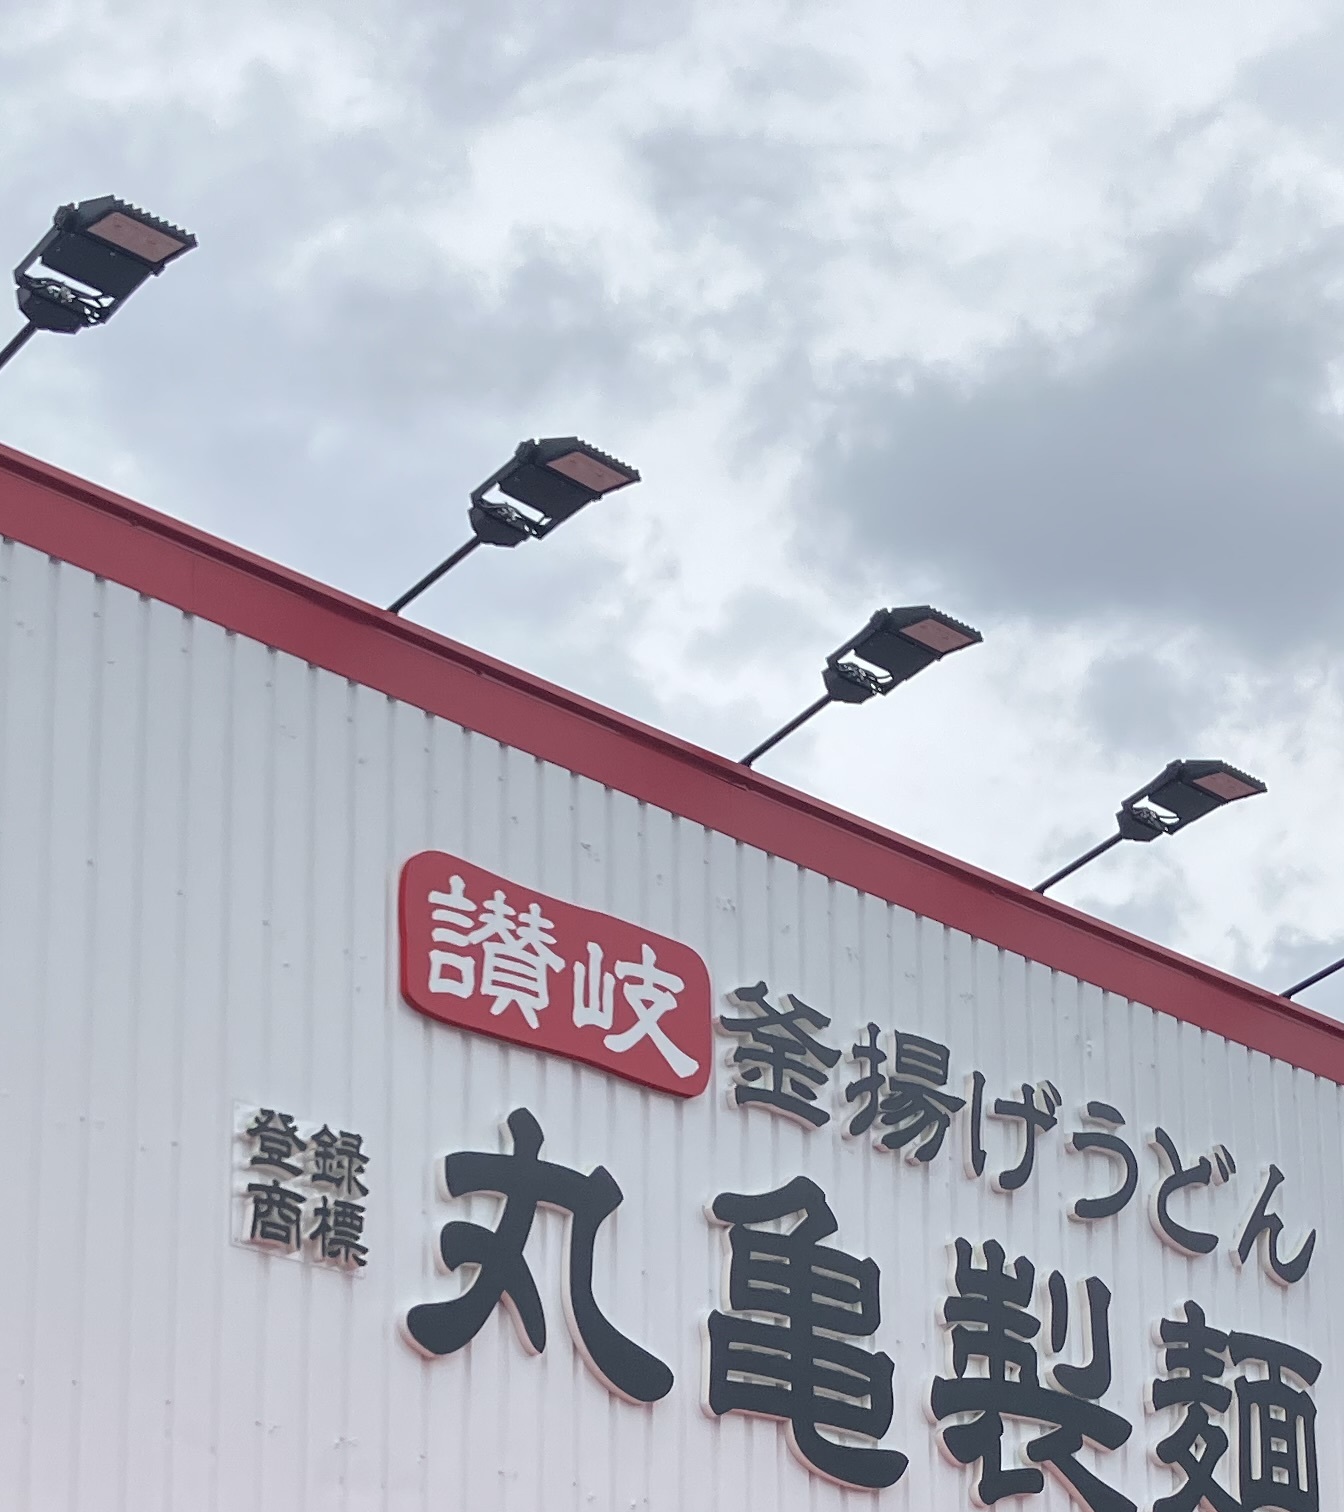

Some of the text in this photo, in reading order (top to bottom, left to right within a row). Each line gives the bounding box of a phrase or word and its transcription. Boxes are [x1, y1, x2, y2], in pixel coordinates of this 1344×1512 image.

[428, 875, 700, 1082] 讃岐
[247, 1108, 370, 1197] 登録
[718, 981, 1318, 1285] 釜揚げうどん
[248, 1179, 369, 1267] 商標
